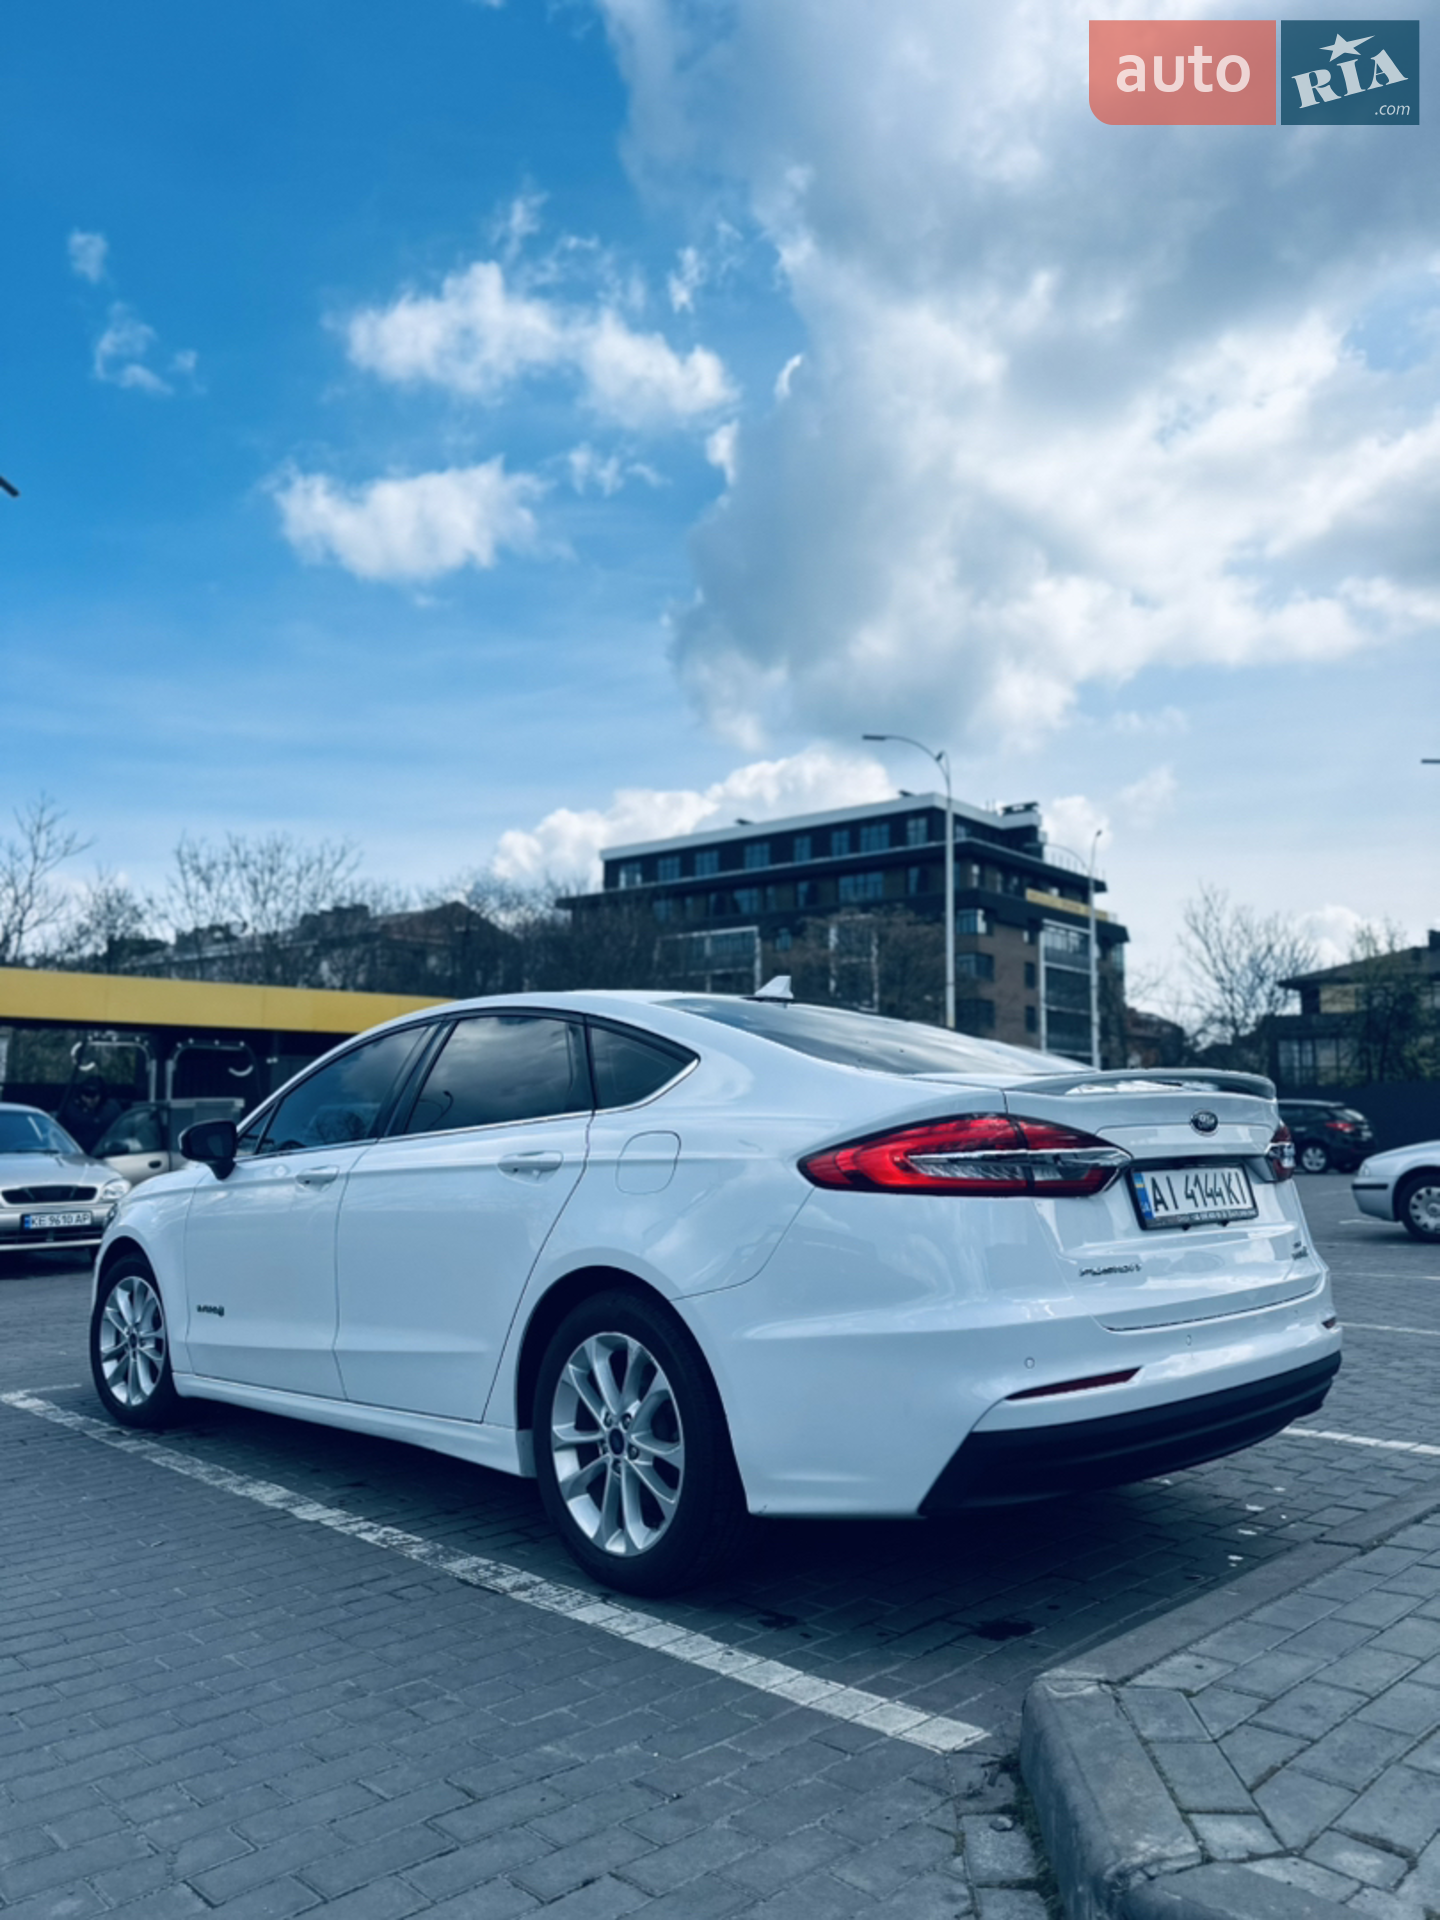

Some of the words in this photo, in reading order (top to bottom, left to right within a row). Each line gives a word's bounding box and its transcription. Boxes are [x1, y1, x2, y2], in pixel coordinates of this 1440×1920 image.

[1151, 1175, 1179, 1212] AI
[31, 1216, 46, 1227] KE
[48, 1214, 73, 1226] 9610
[75, 1213, 90, 1223] AP
